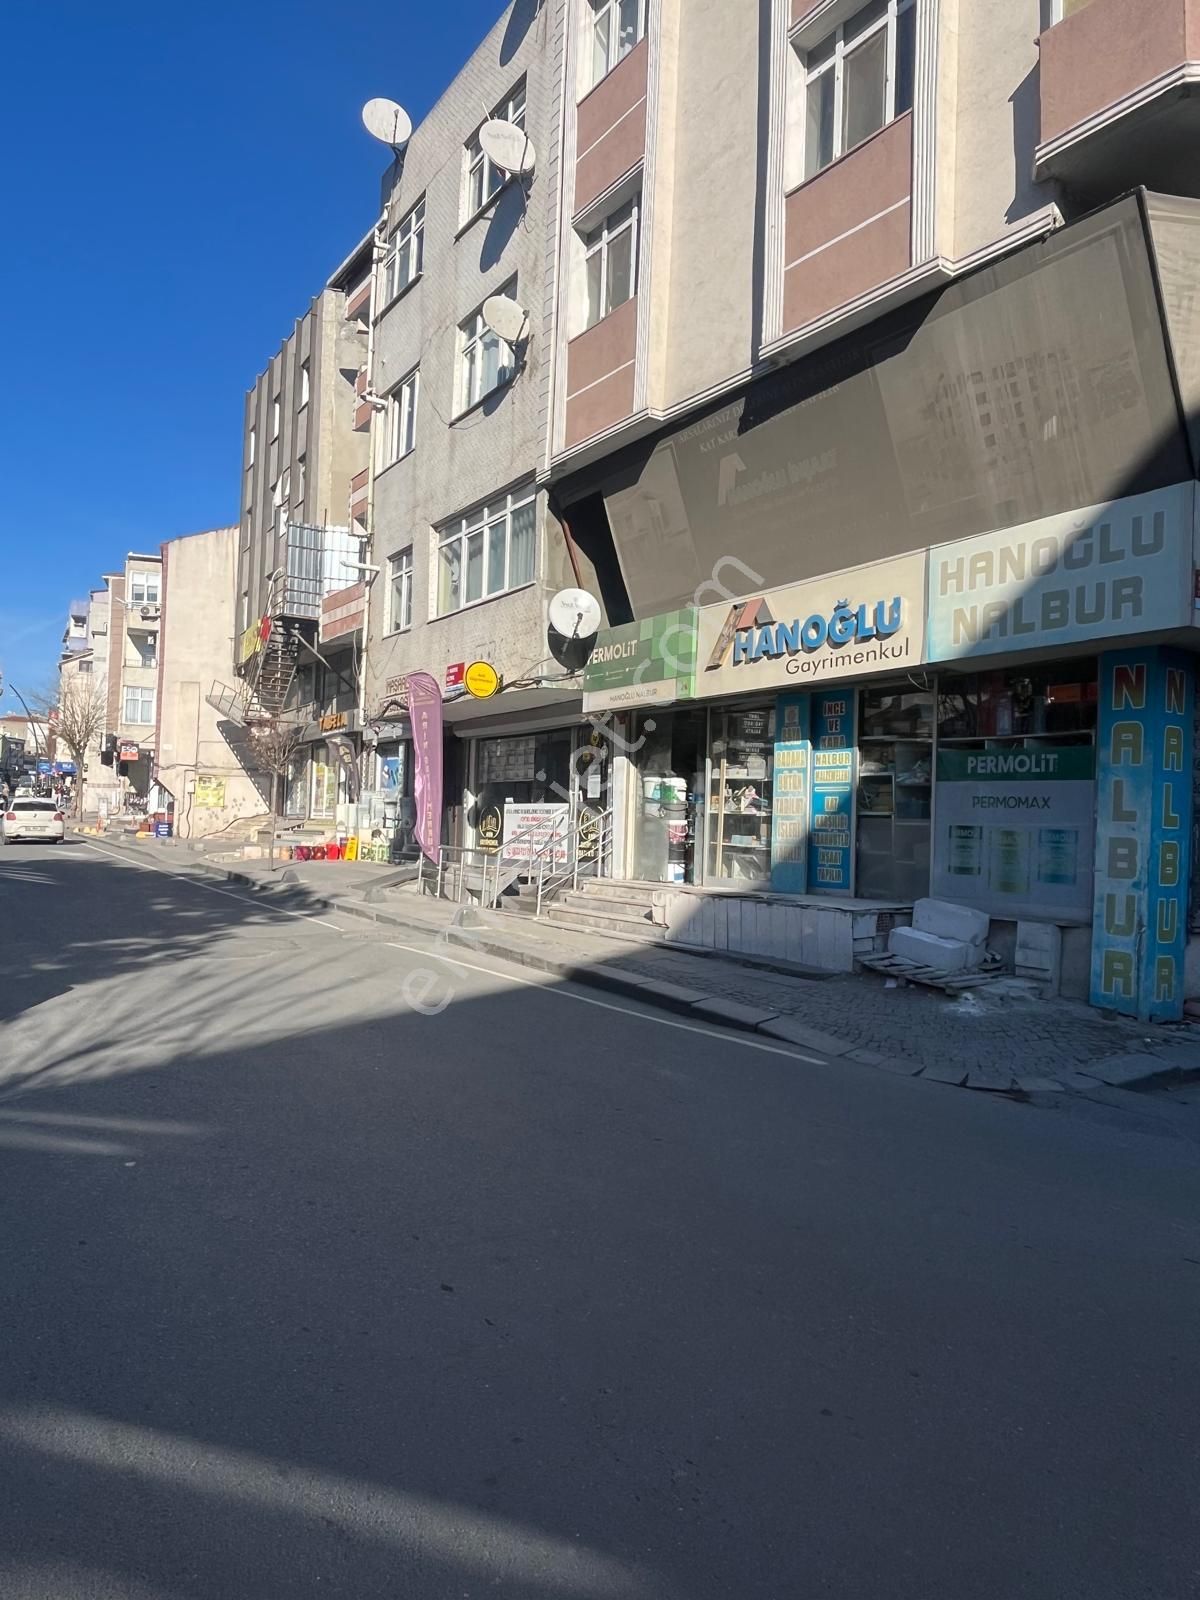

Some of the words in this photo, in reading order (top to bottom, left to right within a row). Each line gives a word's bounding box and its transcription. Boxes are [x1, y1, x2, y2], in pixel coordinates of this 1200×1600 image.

[940, 511, 1165, 596] HANOĞLU
[733, 597, 904, 667] HANOĞLU
[953, 575, 1143, 646] NALBUR
[785, 638, 910, 676] Gayrimenkul
[815, 752, 851, 766] NALBUR
[972, 796, 1051, 810] PERMOMAX
[1103, 663, 1147, 998] NALBUR
[1156, 667, 1186, 1001] NALBUR
